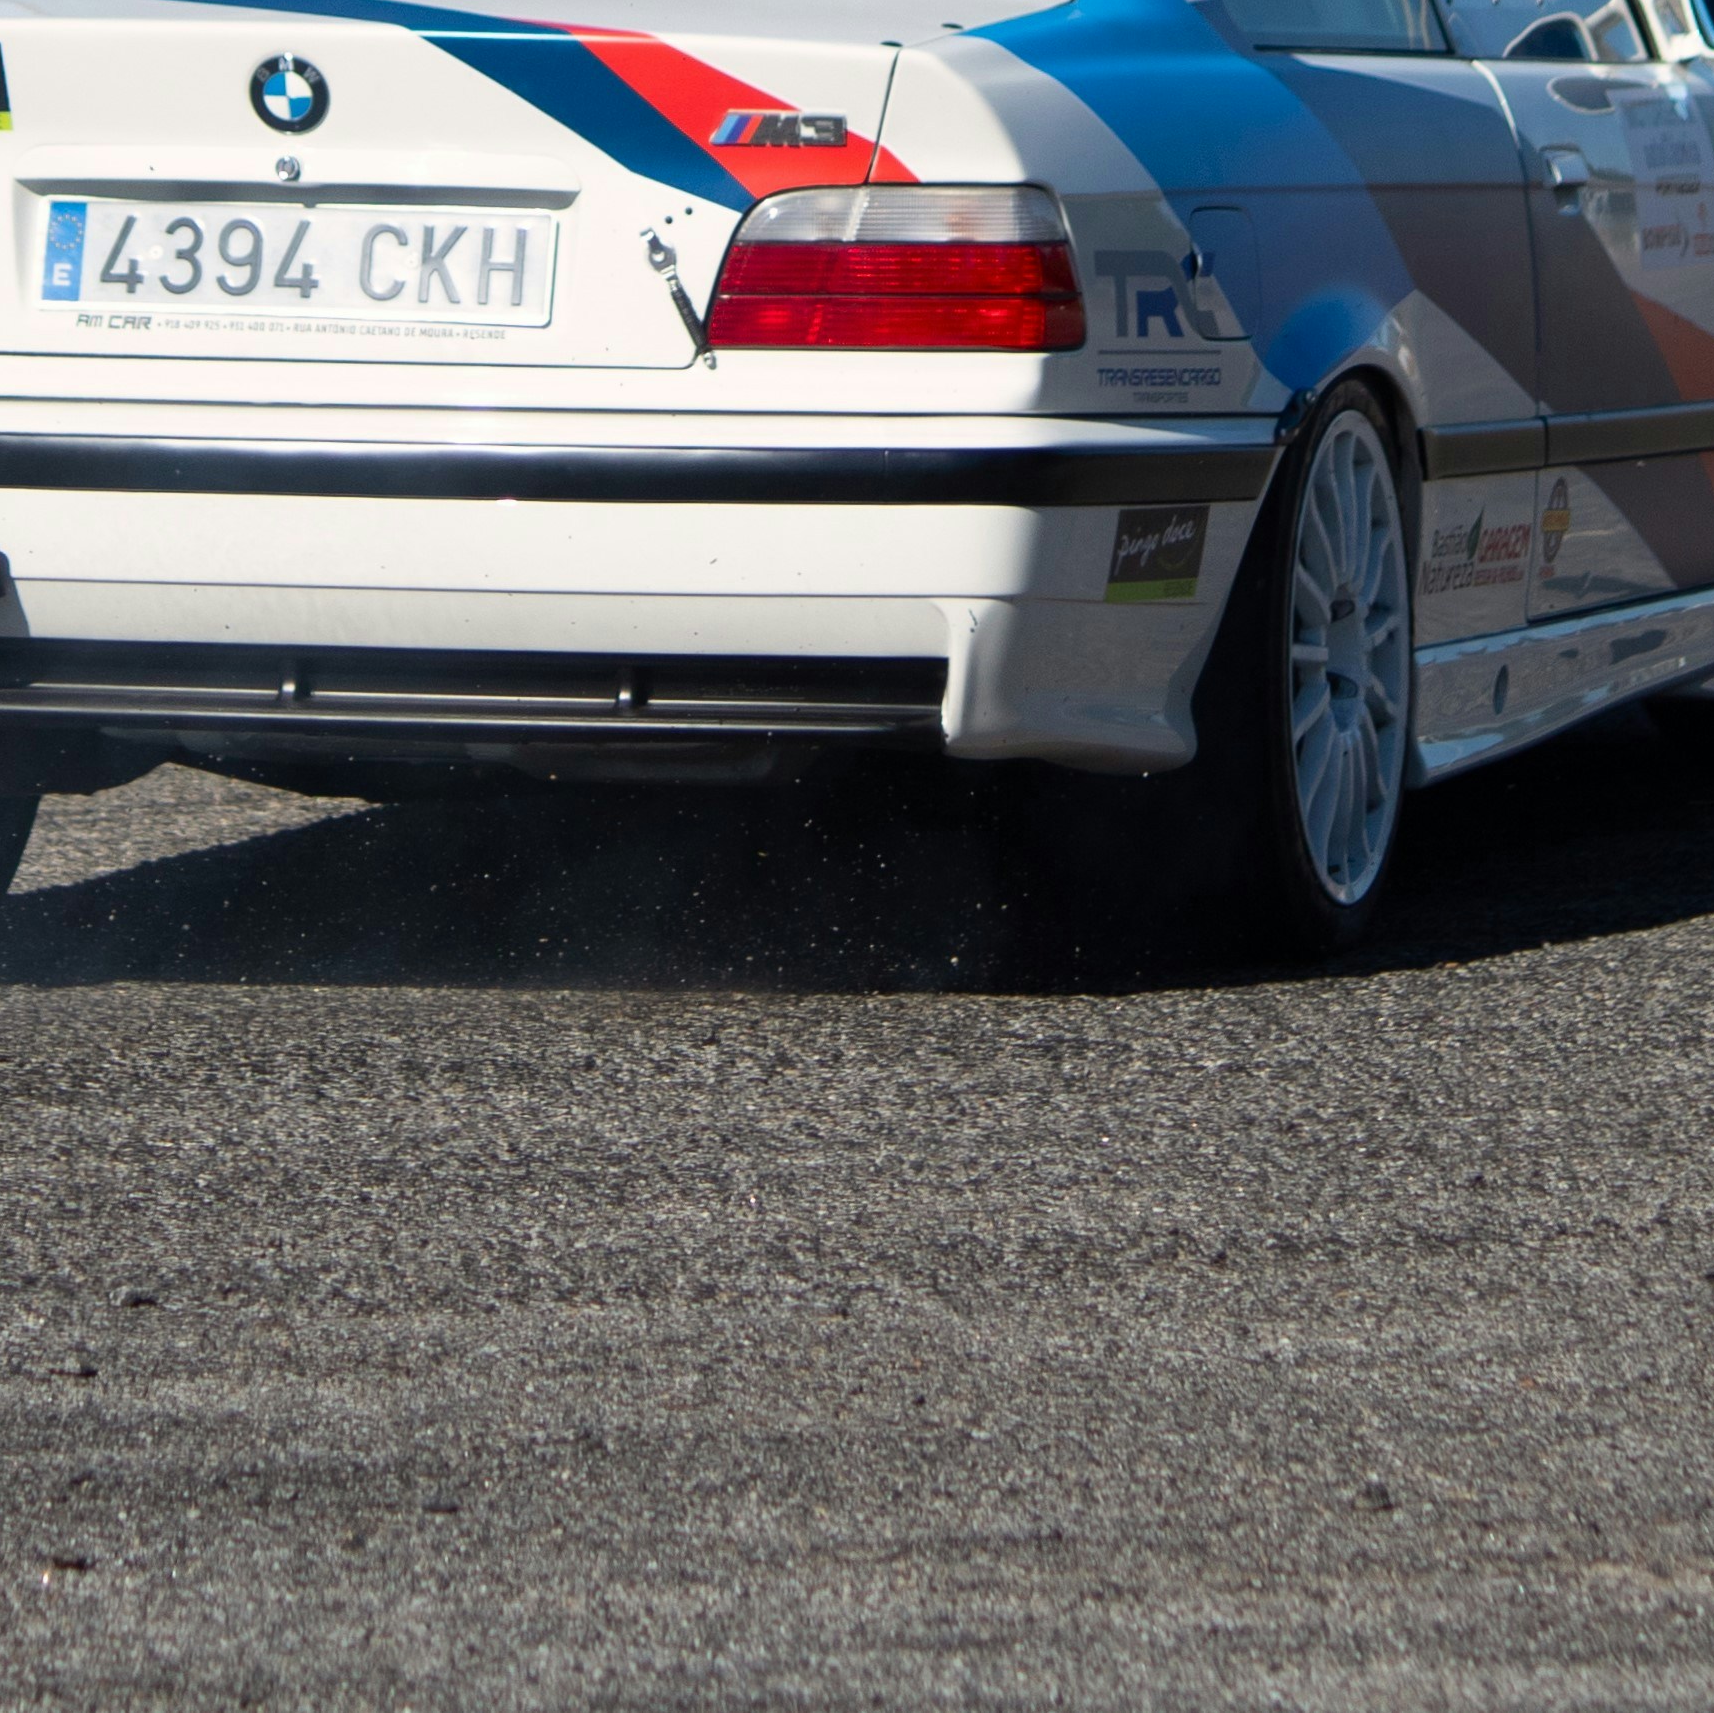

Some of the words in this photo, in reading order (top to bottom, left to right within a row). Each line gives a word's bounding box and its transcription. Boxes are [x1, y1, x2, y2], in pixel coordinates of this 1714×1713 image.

[747, 113, 847, 147] M3
[52, 263, 72, 286] E
[99, 215, 319, 299] 4394
[359, 223, 527, 307] CKH
[108, 315, 152, 330] CAR
[293, 322, 312, 334] RUA
[359, 325, 401, 337] CAETANO
[404, 327, 416, 337] DE
[419, 327, 454, 338] MOURA
[462, 329, 506, 340] RESENDE
[1113, 527, 1160, 576] pingo
[1161, 514, 1197, 547] doce
[1478, 523, 1532, 563] GARAGEM
[1419, 561, 1474, 595] Natureza
